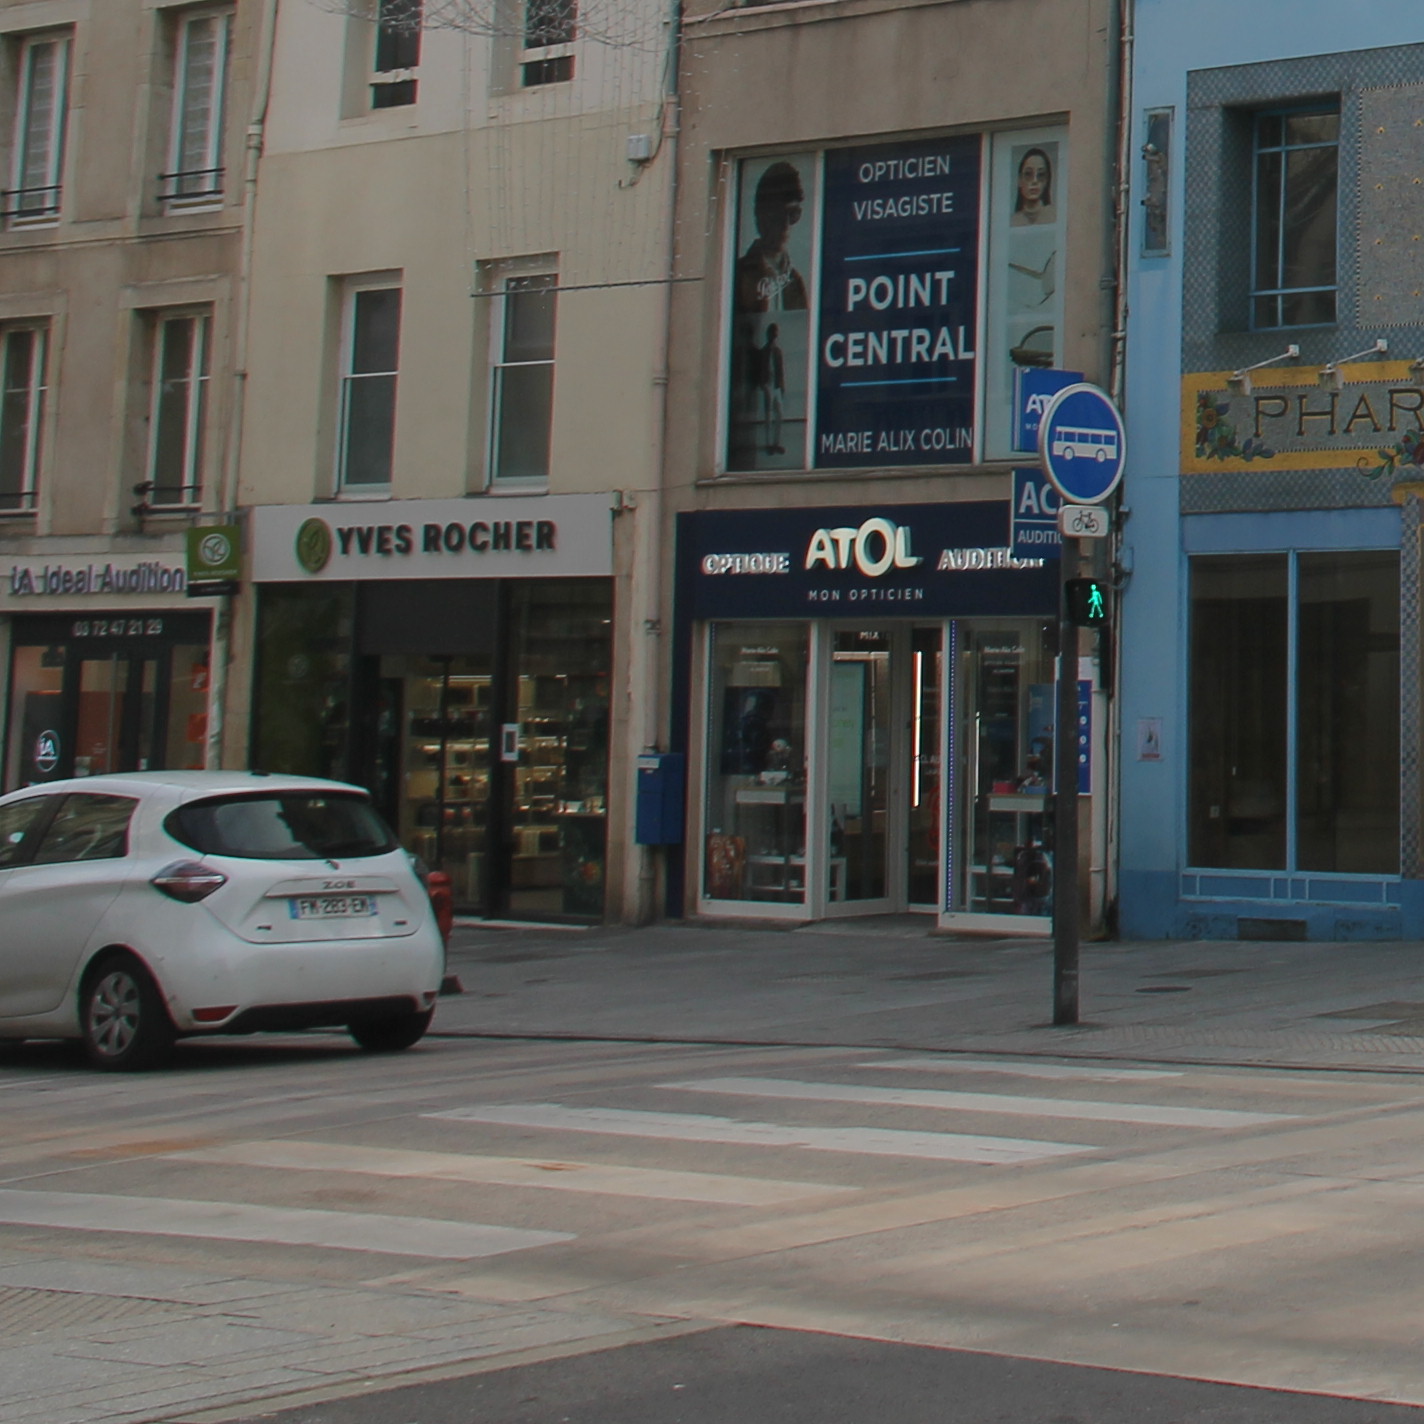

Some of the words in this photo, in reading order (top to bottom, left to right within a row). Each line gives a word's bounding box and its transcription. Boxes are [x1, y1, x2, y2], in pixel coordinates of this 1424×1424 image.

[858, 154, 951, 184] OPTICIEN
[853, 191, 954, 222] VISAGISTE
[846, 270, 956, 313] POINT
[823, 324, 976, 369] CENTRAL
[820, 430, 873, 455] MARIE
[877, 428, 916, 453] ALIX
[920, 426, 974, 452] COLIN
[336, 524, 414, 555] YVES
[422, 520, 557, 554] ROCHER
[702, 551, 790, 575] OPTIQUE
[804, 516, 924, 577] ATOL
[1017, 529, 1063, 545] AUDITI
[44, 563, 93, 594] Ideal
[101, 560, 186, 594] Audition
[808, 588, 841, 601] MON
[849, 587, 925, 601] OPTICIEN
[91, 620, 108, 636] 72
[109, 619, 126, 636] 47
[127, 619, 143, 635] 21
